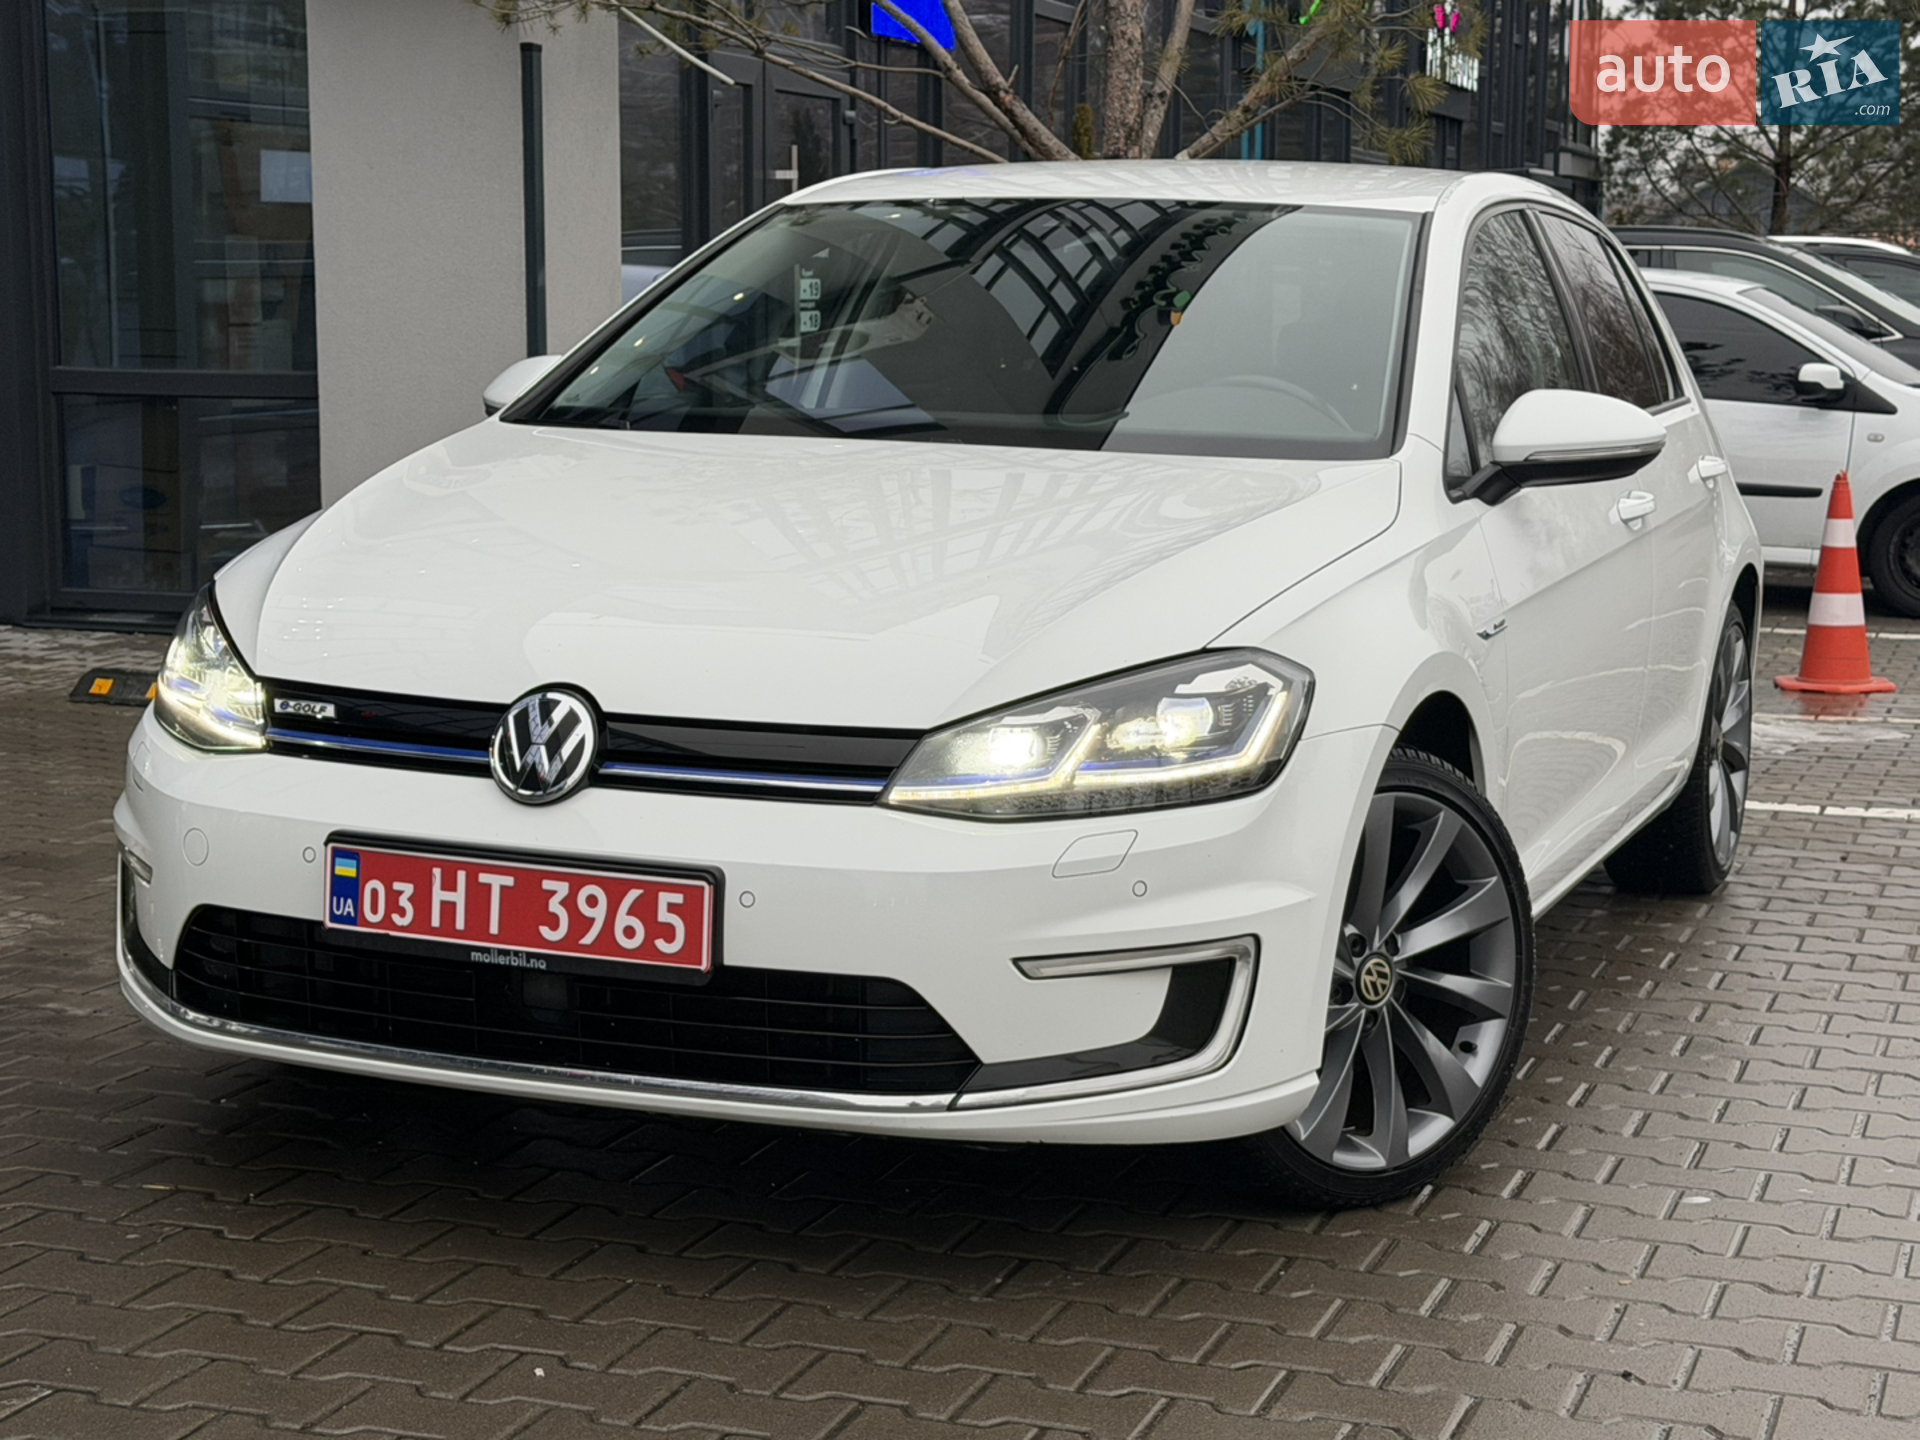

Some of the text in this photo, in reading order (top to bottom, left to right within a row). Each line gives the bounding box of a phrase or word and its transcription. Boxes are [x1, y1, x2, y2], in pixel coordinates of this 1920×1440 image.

[332, 896, 356, 918] UA
[362, 866, 686, 955] 03 HT 3965
[470, 947, 547, 970] mollerbil.no
